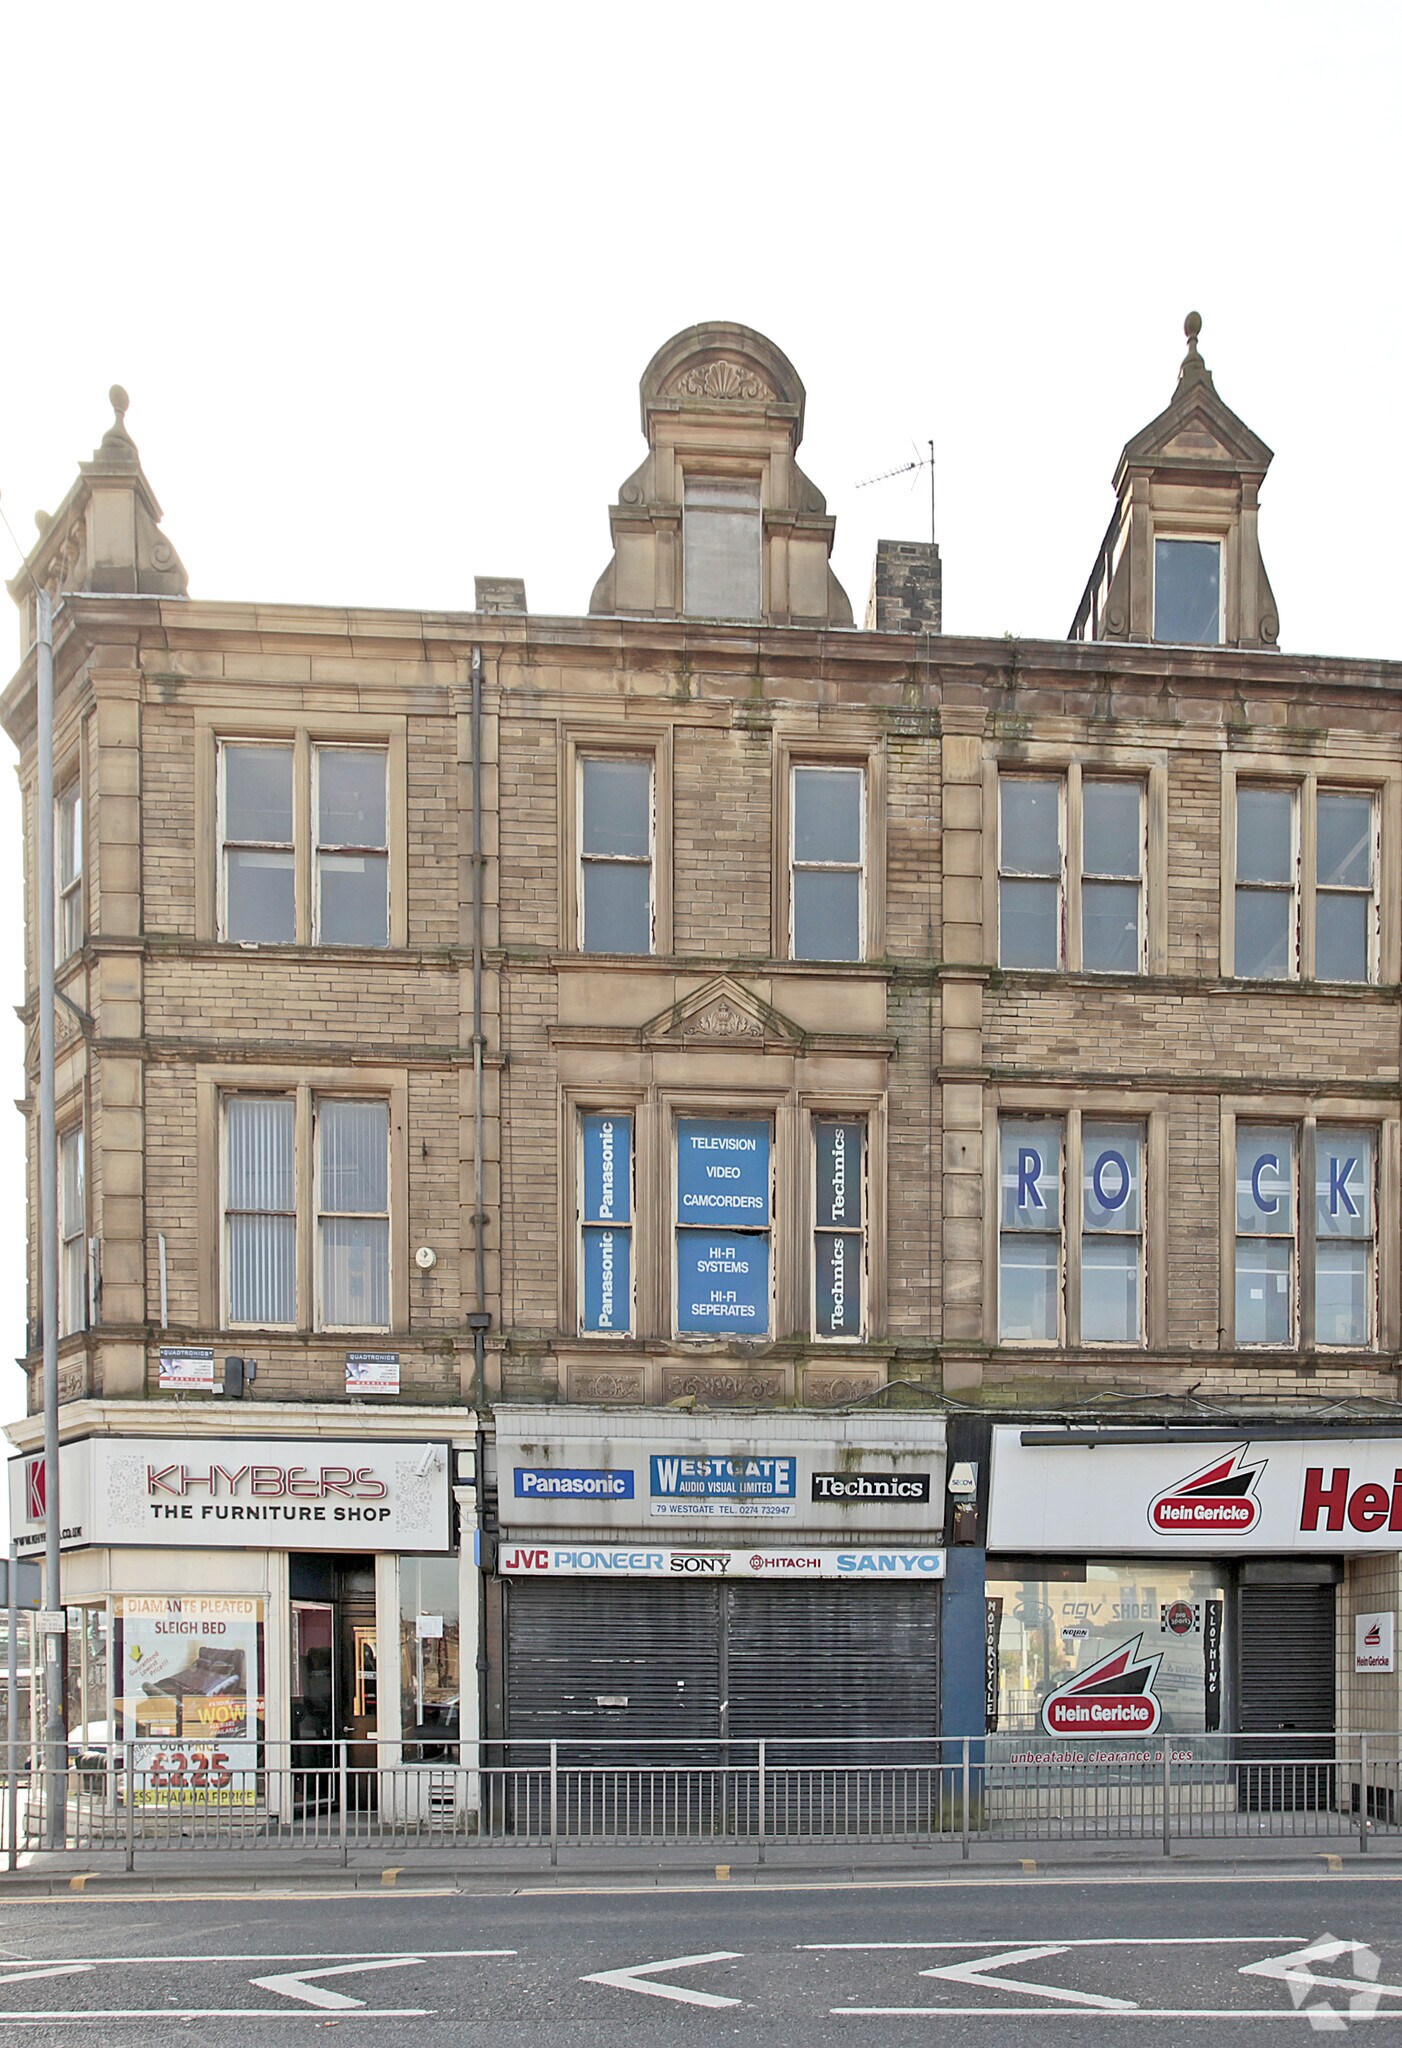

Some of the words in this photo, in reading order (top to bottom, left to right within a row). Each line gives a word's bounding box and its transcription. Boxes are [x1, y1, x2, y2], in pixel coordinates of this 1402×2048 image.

[690, 1137, 756, 1151] TELEVISION
[599, 1121, 614, 1219] Panasonic
[706, 1166, 741, 1179] VIDEO
[832, 1128, 845, 1221] Technics
[683, 1194, 764, 1209] CAMCORDERS
[709, 1247, 735, 1259] HI-FI
[697, 1260, 749, 1274] SYSTEMS
[598, 1231, 614, 1328] Panasonic
[831, 1238, 844, 1330] Technics
[710, 1291, 736, 1303] HI-FI
[691, 1303, 755, 1317] SEPERATES
[147, 1464, 388, 1499] KHYBERS
[522, 1473, 626, 1493] Panasonic
[657, 1458, 790, 1494] WESTGATE
[679, 1481, 705, 1493] AUDIO
[708, 1481, 737, 1493] VISUAL
[740, 1482, 773, 1494] LIMITED
[815, 1477, 923, 1497] Technics
[150, 1504, 193, 1519] THE
[202, 1506, 326, 1521] FURNITURE
[334, 1507, 391, 1522] SHOP
[656, 1504, 667, 1513] 79
[669, 1505, 714, 1514] WESTGATE
[719, 1505, 737, 1514] TEL.
[739, 1506, 758, 1514] 0274
[761, 1506, 790, 1515] 732947
[1160, 1505, 1193, 1520] Hein
[1194, 1504, 1249, 1520] Gericke
[505, 1550, 549, 1569] JVC
[555, 1551, 663, 1570] PIONEER
[670, 1557, 731, 1572] SONY
[764, 1557, 821, 1568] HITACHI
[837, 1554, 939, 1572] SANYO
[128, 1599, 198, 1613] DIAMANTE
[201, 1600, 253, 1613] PLEATED
[1112, 1603, 1153, 1619] SHOEI
[155, 1621, 198, 1634] SLEIGH
[202, 1621, 227, 1634] BED
[1062, 1629, 1088, 1638] NOLAN
[1208, 1604, 1218, 1693] CLOTHING
[129, 1651, 159, 1677] Guaranteed
[987, 1601, 996, 1716] MOTORCYCLE
[1356, 1656, 1368, 1667] Hein
[1368, 1655, 1389, 1667] Gericke
[140, 1660, 158, 1677] Lowest
[197, 1704, 246, 1725] WOW
[1055, 1704, 1090, 1722] Hein
[1090, 1704, 1149, 1722] Gericke
[159, 1740, 184, 1751] OUR
[187, 1740, 219, 1751] PRICE
[1010, 1750, 1084, 1764] unbeatable
[1088, 1749, 1151, 1764] clearance
[150, 1752, 231, 1788] £225
